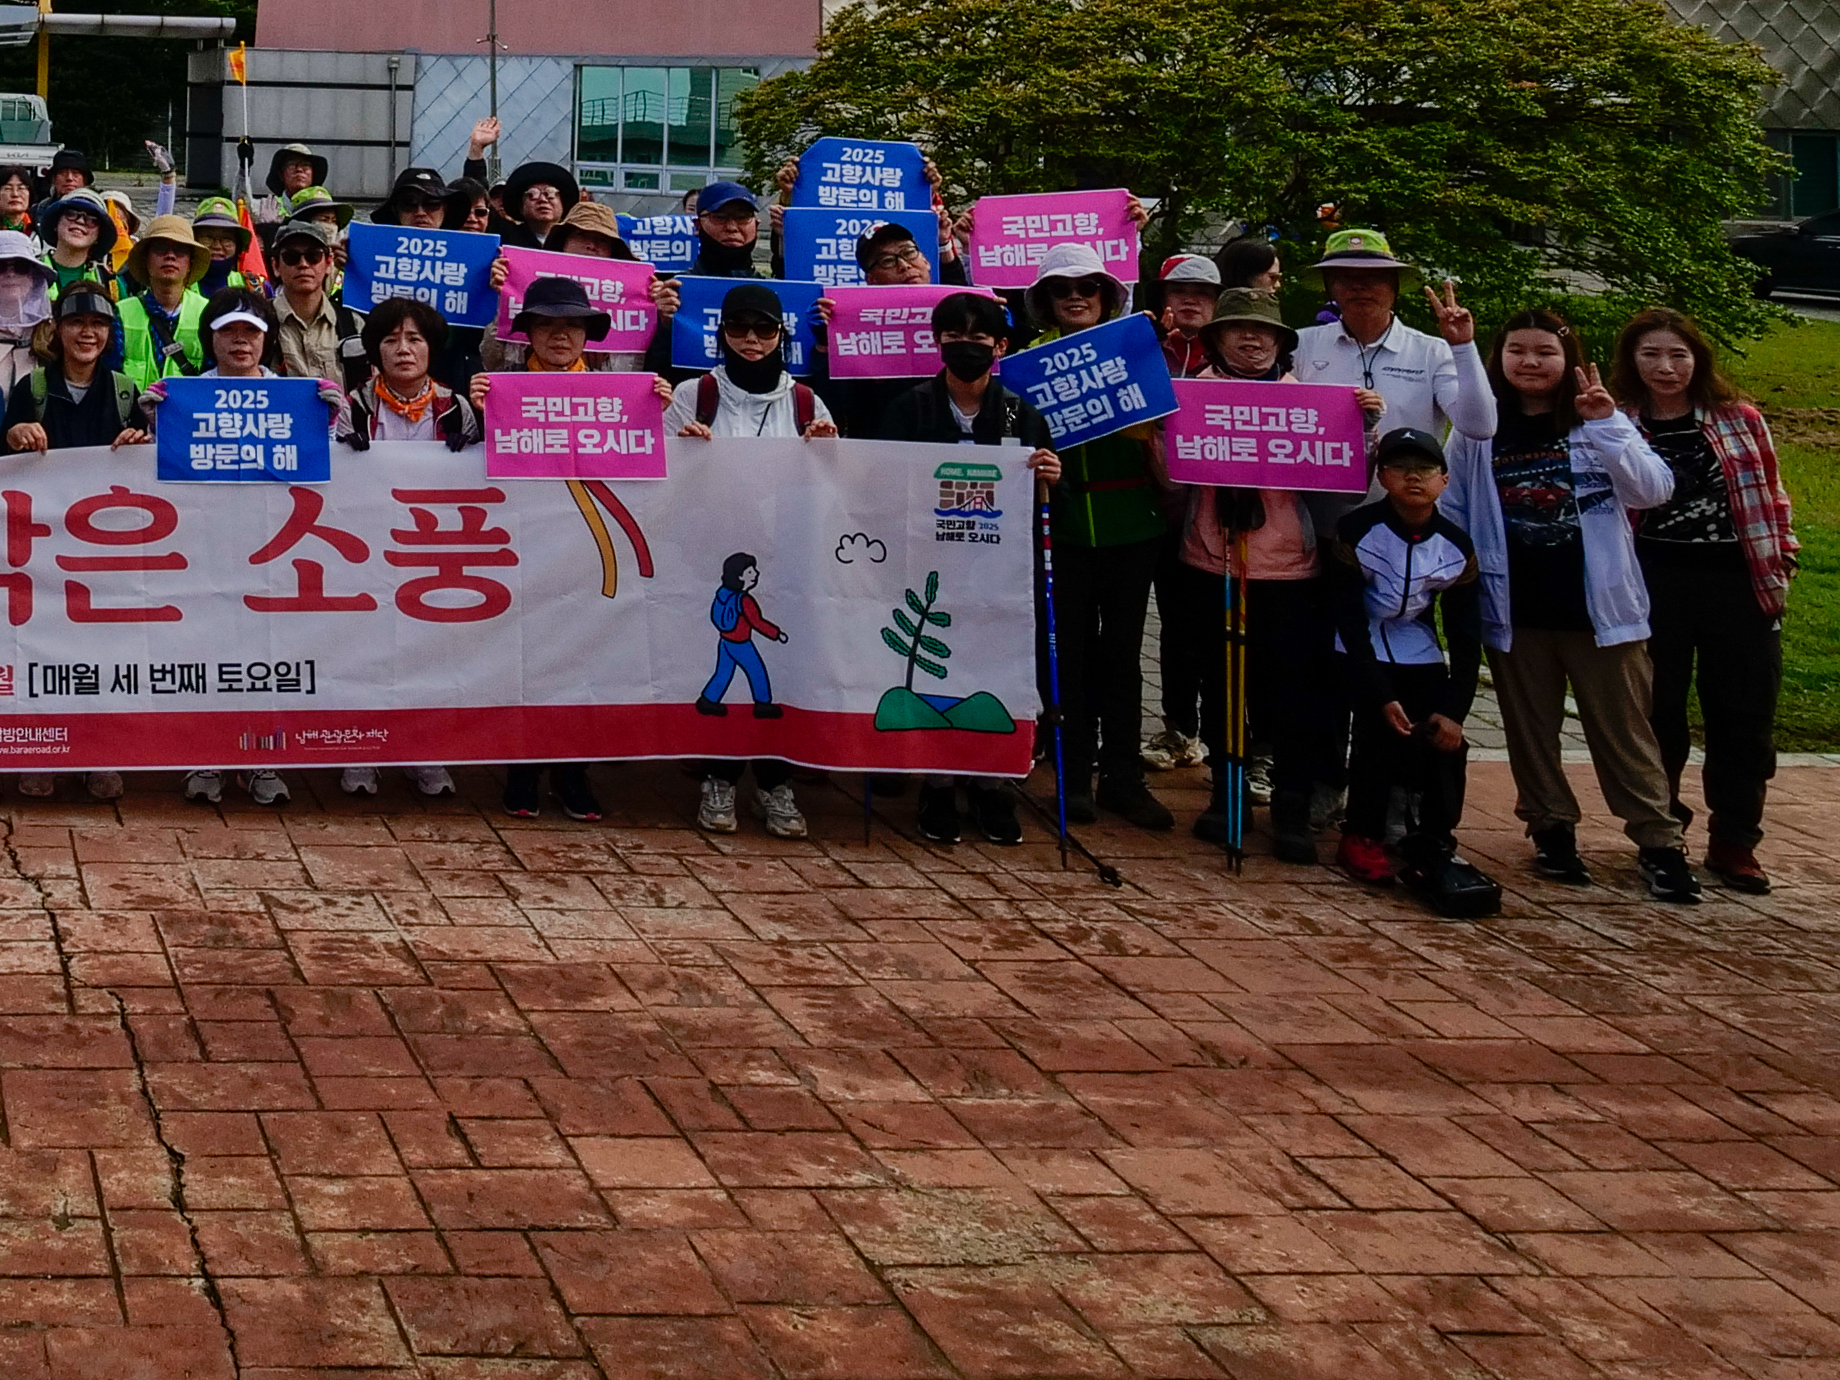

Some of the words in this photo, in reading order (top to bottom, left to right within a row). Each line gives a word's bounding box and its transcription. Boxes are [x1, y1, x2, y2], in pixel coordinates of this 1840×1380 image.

[841, 147, 885, 163] 2025
[821, 163, 903, 187] 고향사랑
[818, 186, 878, 209] 방문의
[884, 191, 904, 210] 해
[632, 216, 694, 235] 고향사
[1002, 212, 1103, 238] 국민고향,
[396, 237, 447, 257] 2025
[630, 240, 691, 261] 방문의
[815, 238, 858, 260] 고향
[978, 243, 1049, 266] 남해로
[373, 255, 468, 286] 고향사랑
[813, 264, 867, 286] 방문
[535, 271, 626, 304] 고향,
[445, 290, 468, 314] 해
[591, 306, 648, 332] 시다
[860, 307, 934, 325] 국민고
[836, 330, 906, 356] 남해로
[1039, 342, 1097, 376] 2025
[1026, 356, 1129, 410] 고향사랑
[215, 390, 269, 409] 2025
[521, 396, 628, 423] 국민고향,
[1117, 383, 1147, 412] 해
[192, 412, 293, 439] 고향사랑
[1205, 405, 1325, 435] 국민고향,
[494, 428, 570, 454] 남해로
[577, 429, 655, 454] 오시다
[1176, 434, 1258, 462] 남해로
[1268, 438, 1353, 467] 오시다
[190, 443, 264, 470] 방문의
[272, 445, 297, 470] 해
[936, 519, 976, 530] 국민고향
[936, 532, 965, 541] 남해로
[969, 532, 1001, 544] 오시다
[243, 485, 520, 623] 소풍
[29, 662, 100, 698] [매월
[110, 664, 138, 695] 세
[150, 663, 207, 694] 번째
[218, 660, 316, 694] 토요일]
